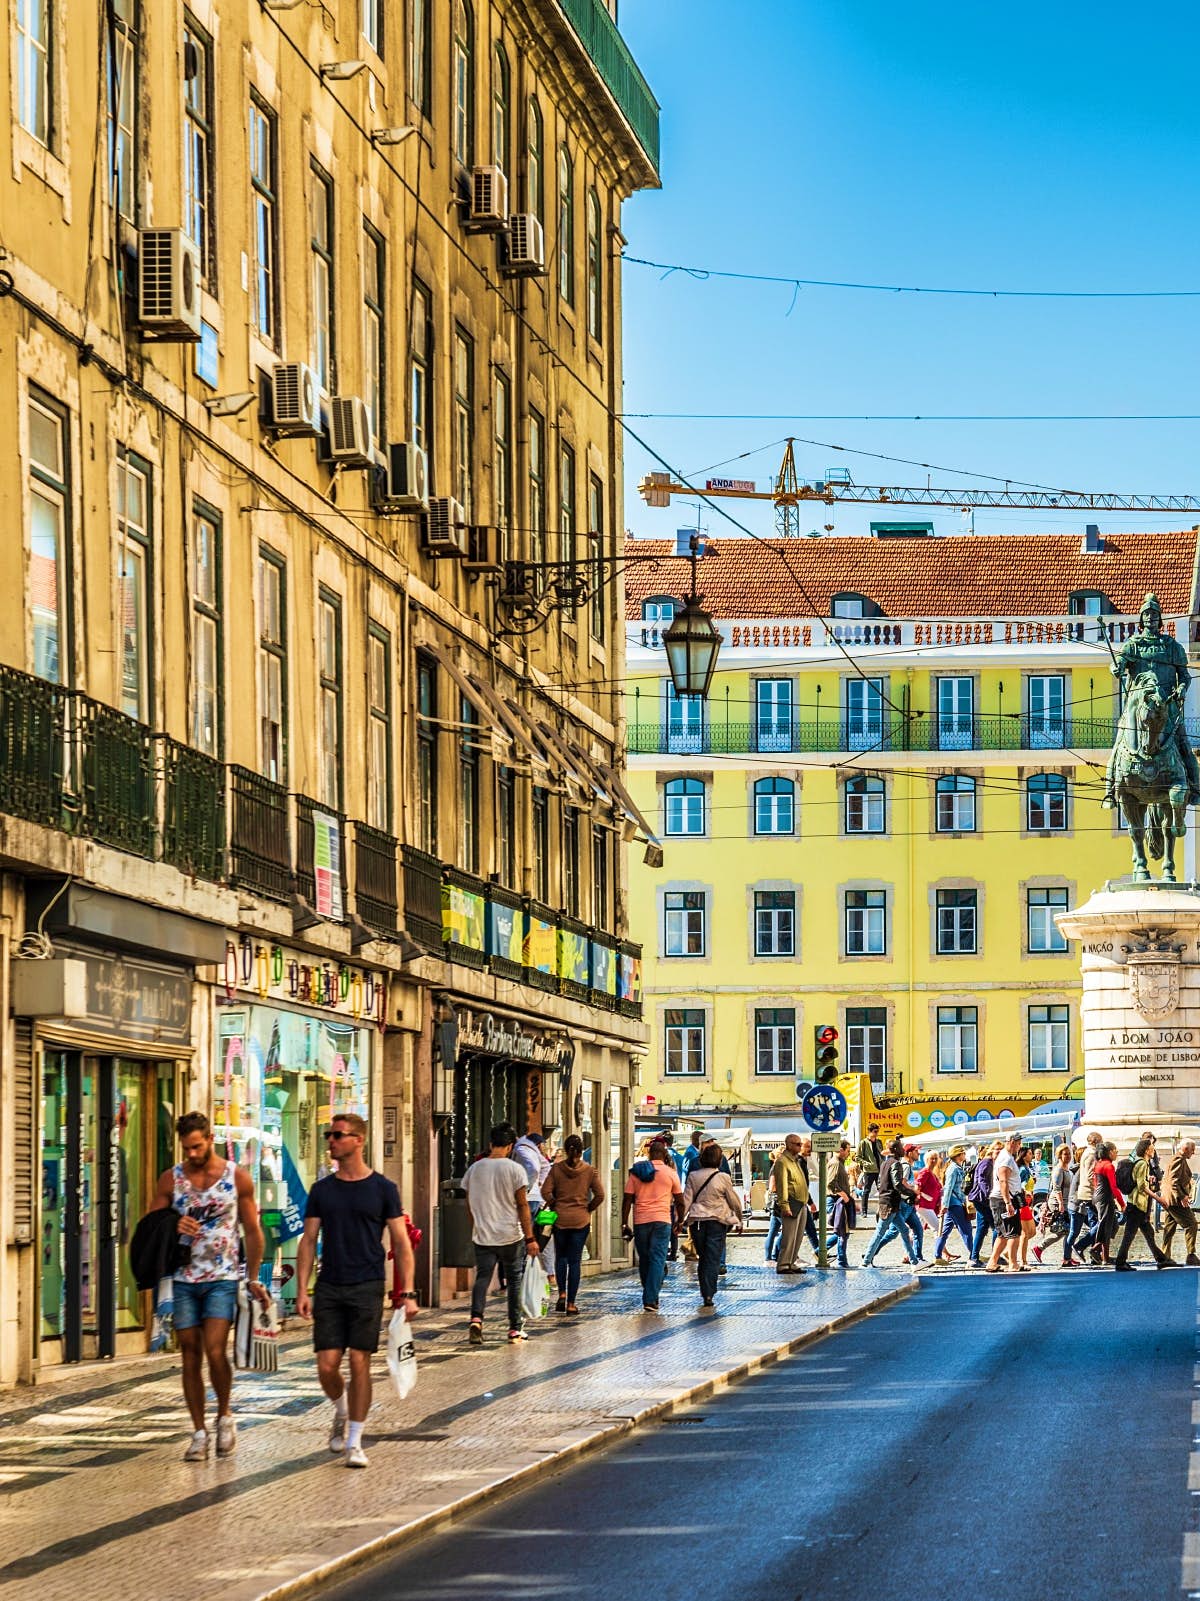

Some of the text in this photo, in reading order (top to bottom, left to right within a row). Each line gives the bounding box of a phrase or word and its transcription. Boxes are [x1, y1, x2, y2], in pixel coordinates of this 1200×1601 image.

[1110, 1034, 1117, 1045] A
[1122, 1033, 1150, 1045] DOM
[1157, 1030, 1194, 1043] JOÃO
[1118, 1055, 1152, 1063] CIDADE
[1156, 1053, 1168, 1062] DE
[868, 1112, 887, 1120] This
[887, 1112, 903, 1122] city
